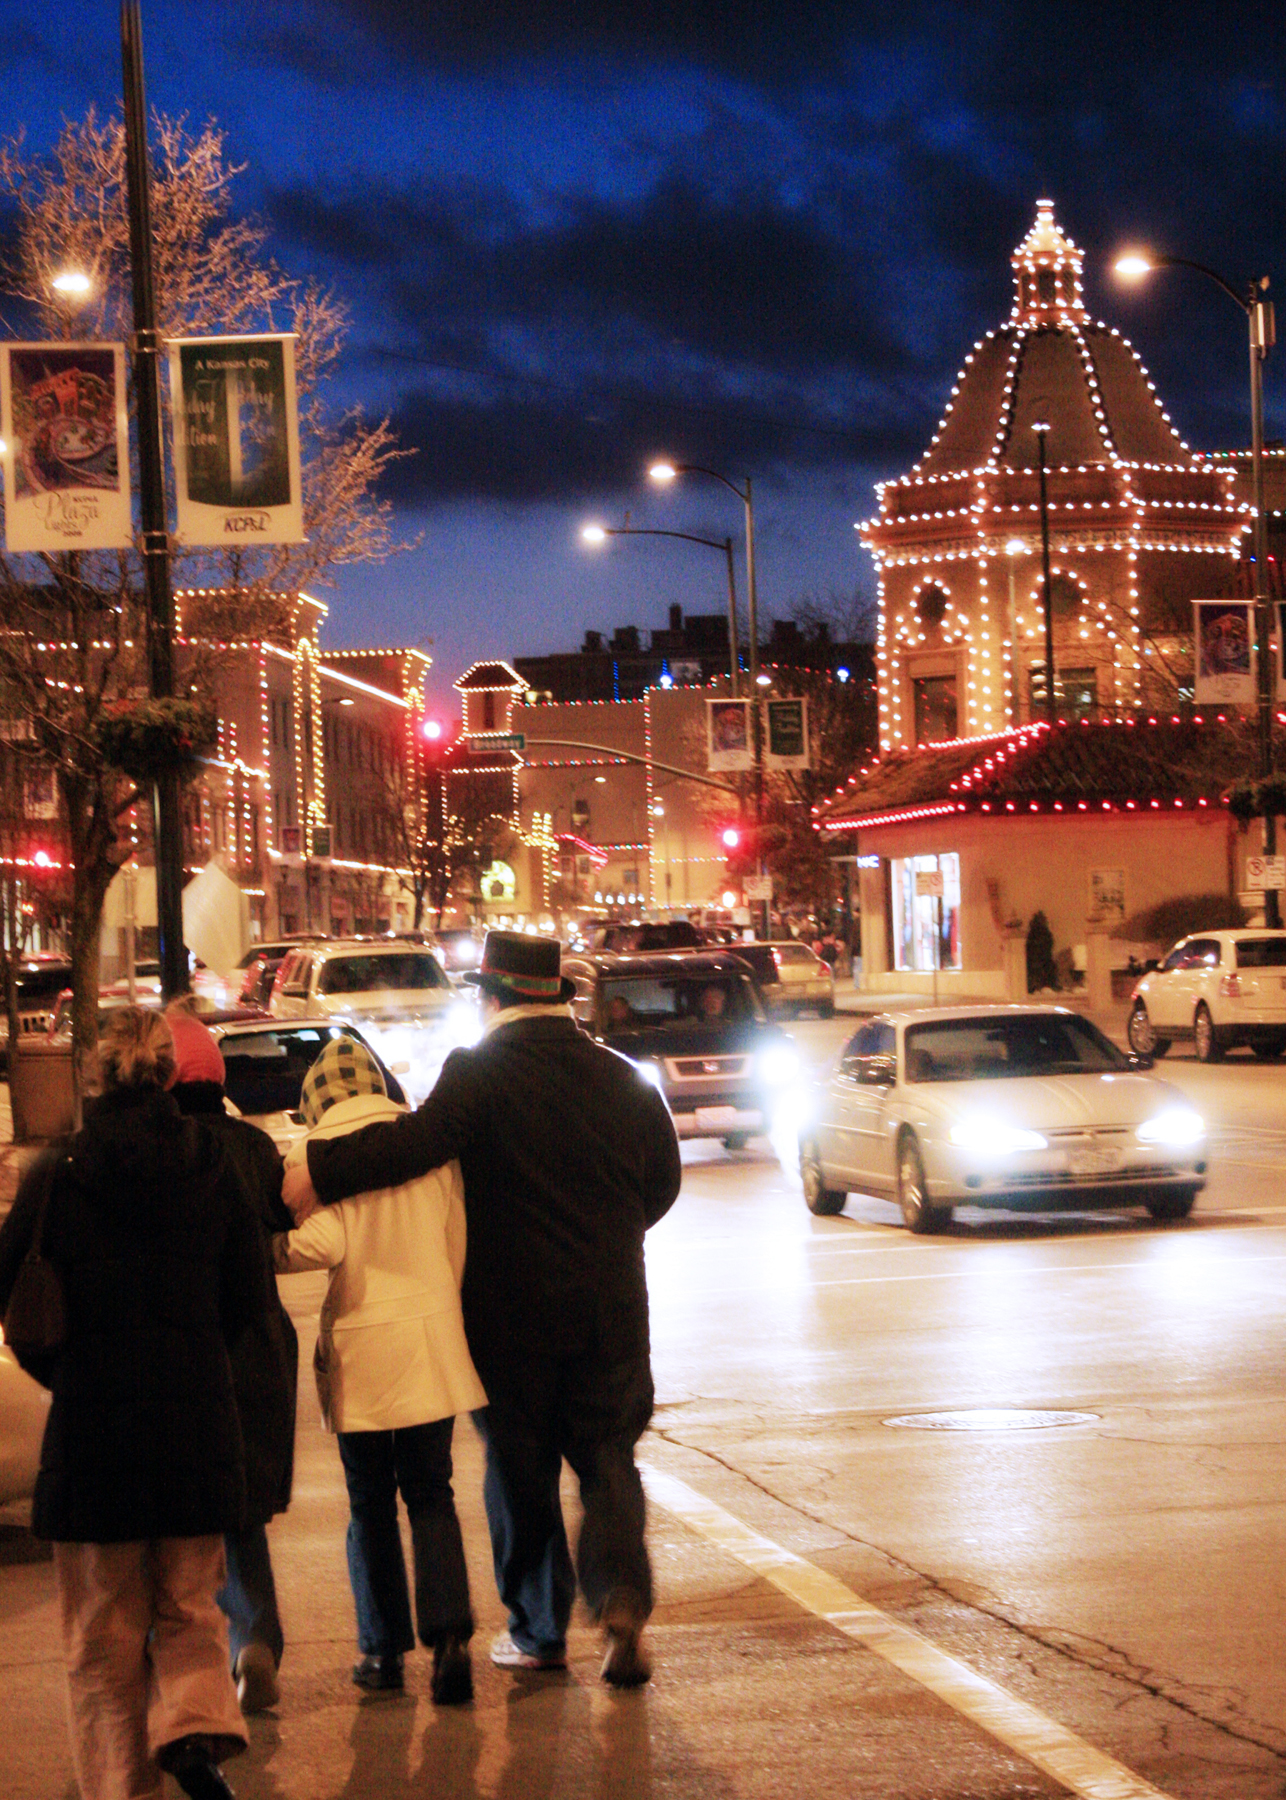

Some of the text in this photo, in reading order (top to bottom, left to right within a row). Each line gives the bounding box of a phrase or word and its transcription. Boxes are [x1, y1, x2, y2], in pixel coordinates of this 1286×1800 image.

[195, 357, 270, 370] A Kansas City
